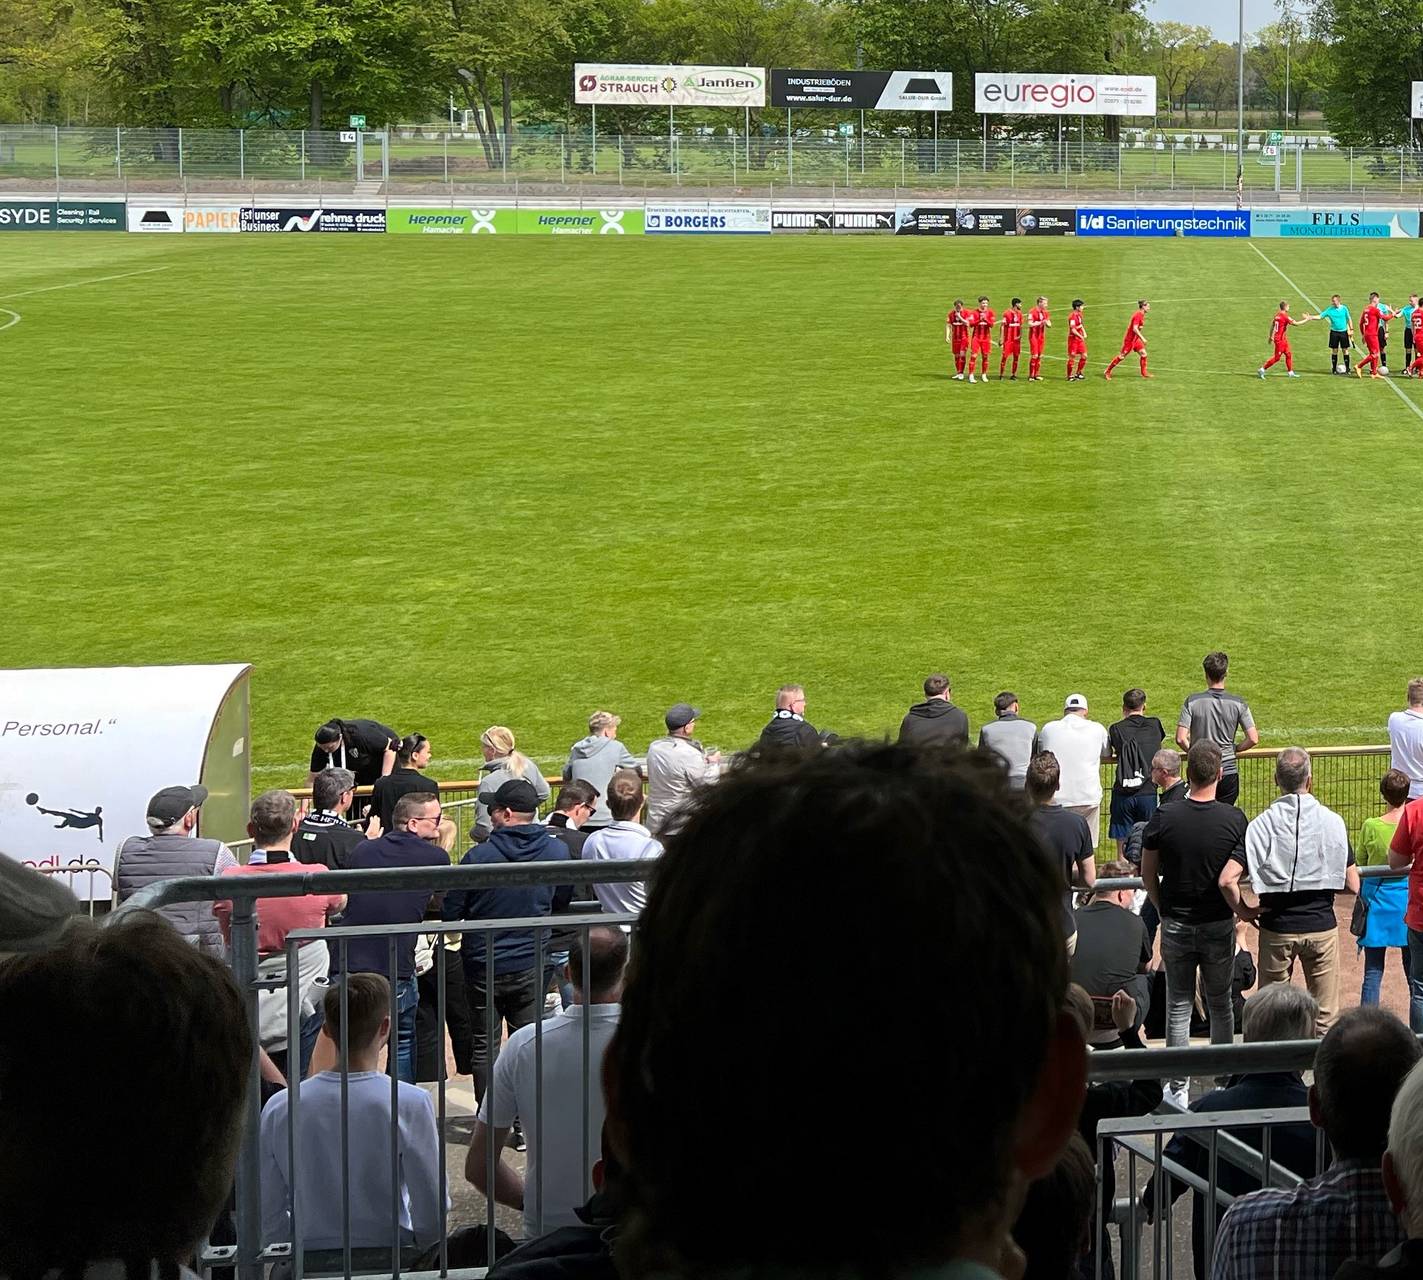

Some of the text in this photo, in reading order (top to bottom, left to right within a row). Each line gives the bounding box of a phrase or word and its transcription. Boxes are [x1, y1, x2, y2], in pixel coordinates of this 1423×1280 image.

[600, 83, 658, 93] STRAUCH
[788, 78, 851, 87] INDUSTRIEBÖDEN
[984, 79, 1095, 109] euregio
[0, 208, 50, 224] SYDE
[56, 208, 84, 216] Cleaning
[241, 209, 280, 220] ist unser
[320, 212, 386, 223] rehms druck
[56, 216, 84, 225] Security
[185, 211, 240, 229] PAPIER
[665, 215, 726, 229] BORGERS
[1106, 216, 1247, 232] Sanierungstechnik
[1312, 212, 1361, 226] FELS
[241, 220, 283, 232] Business.
[422, 225, 464, 234] Hamacher
[1289, 226, 1383, 236] MONOLITHBETON
